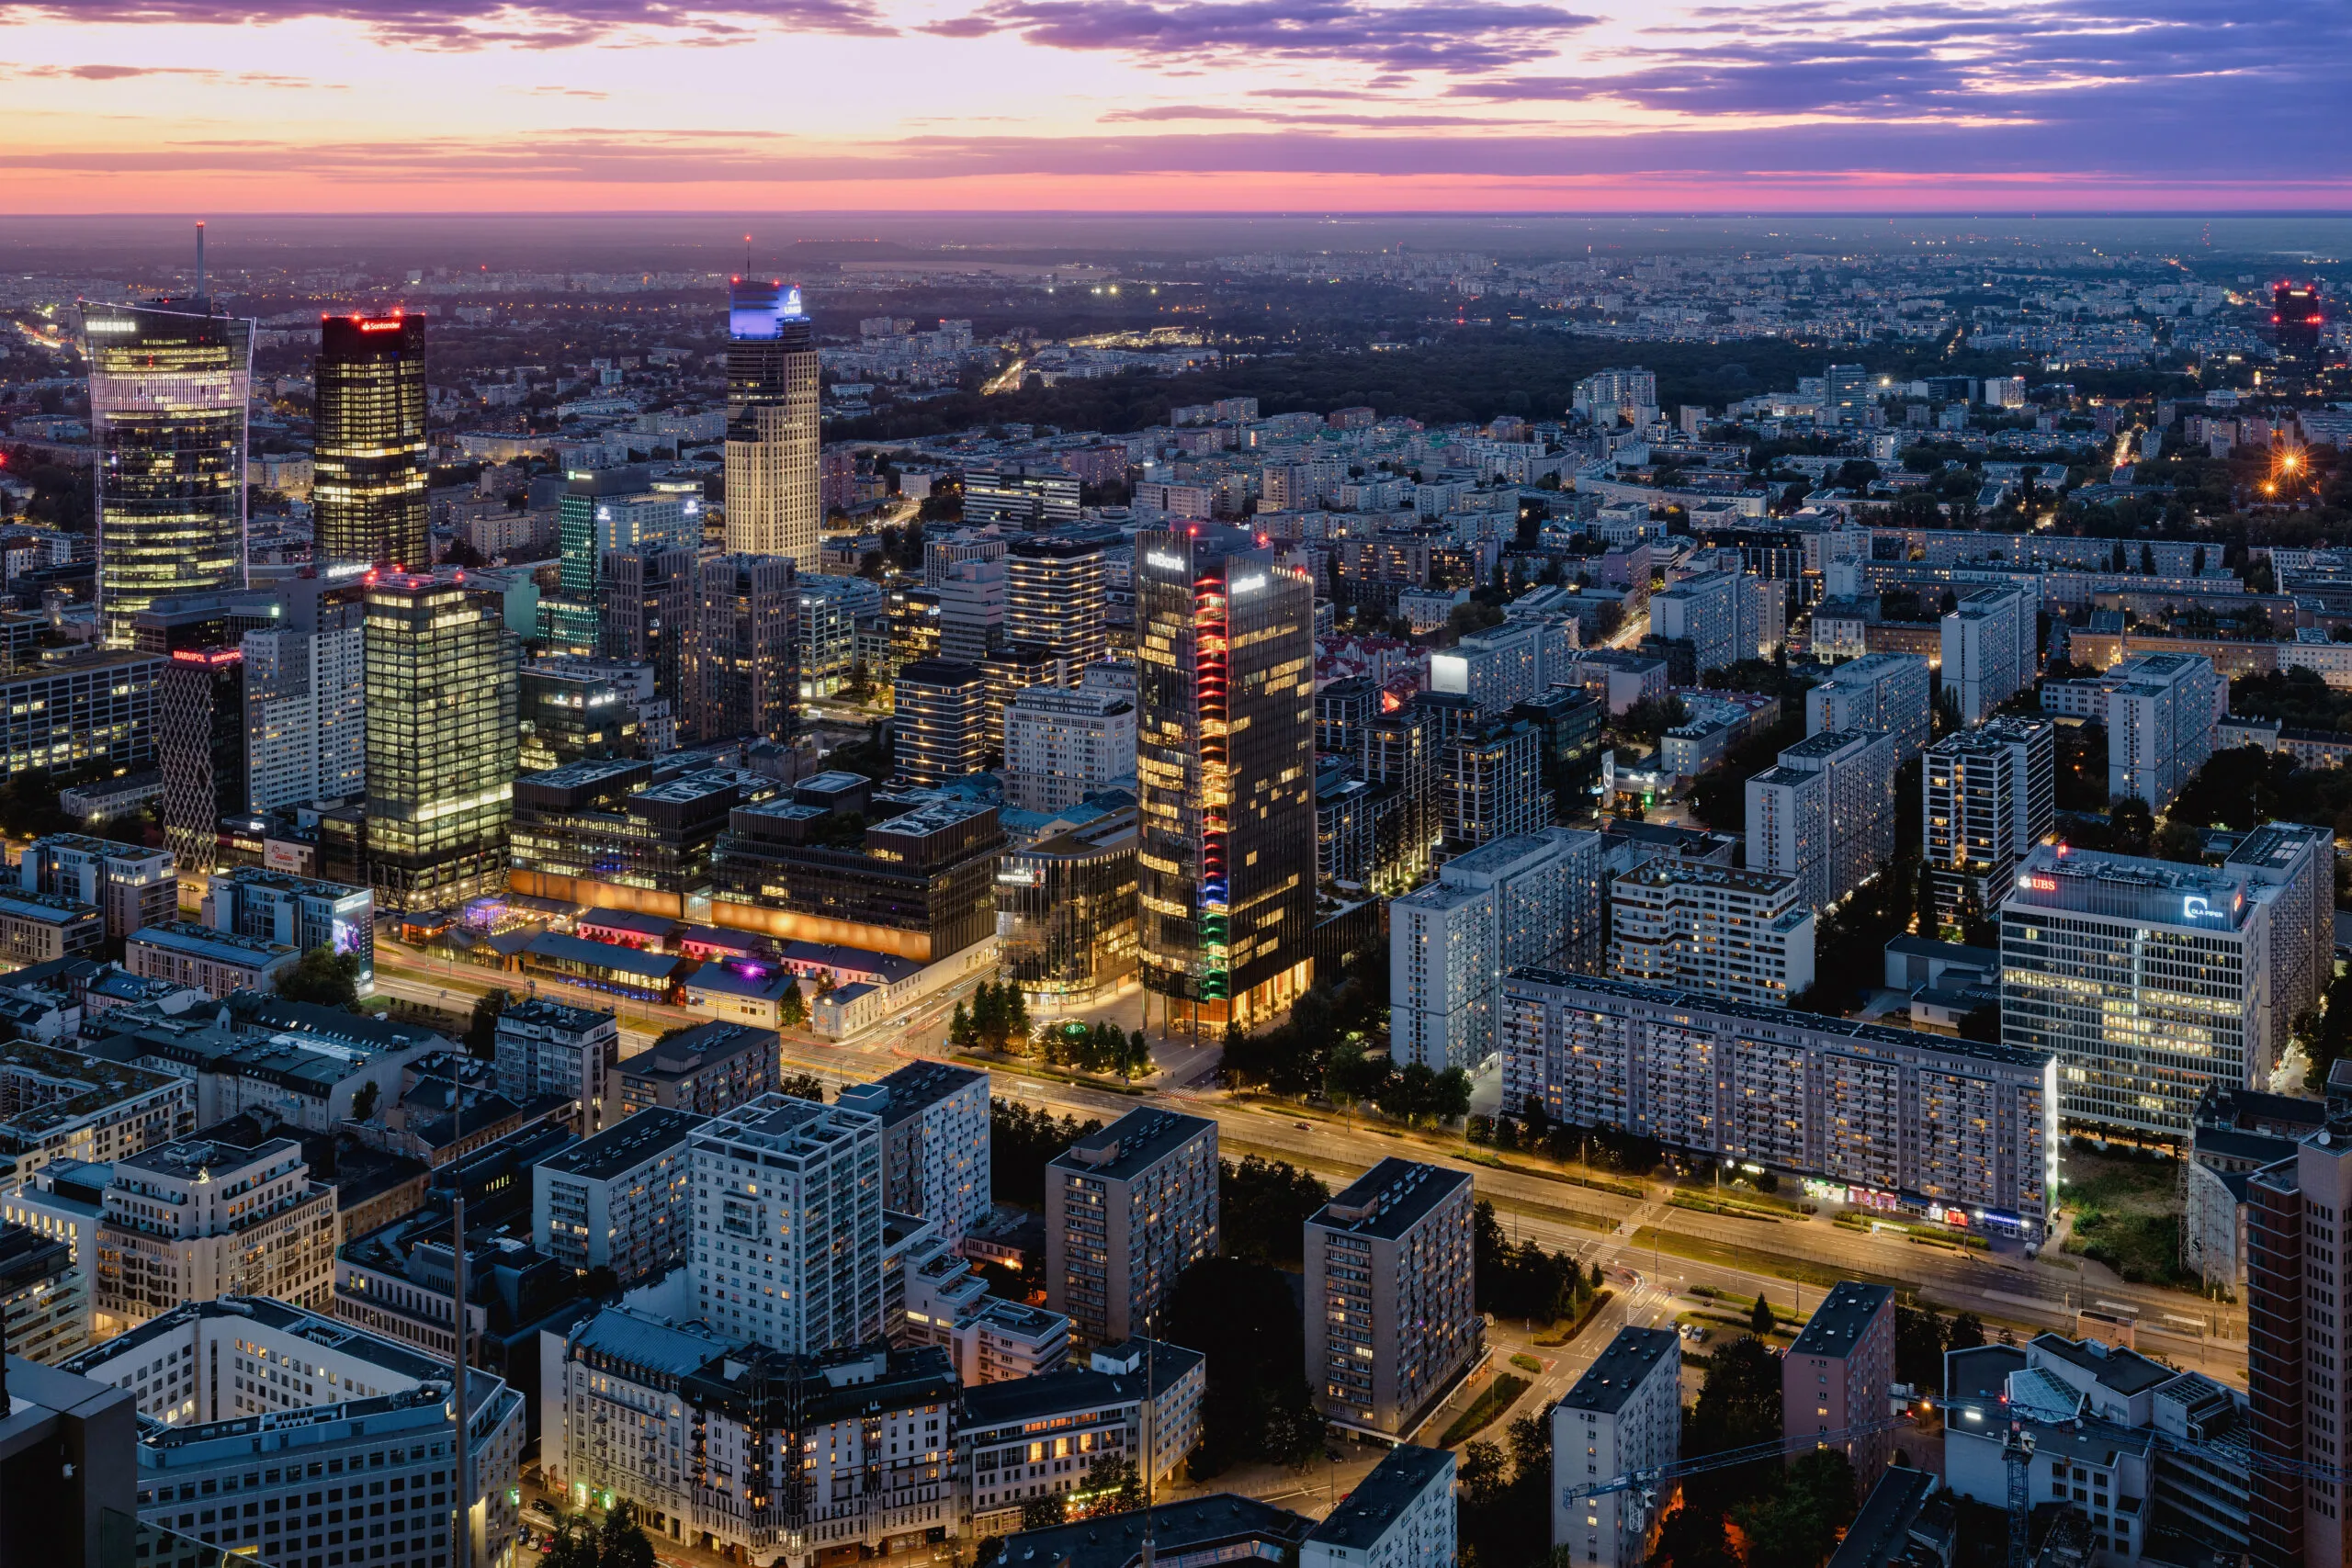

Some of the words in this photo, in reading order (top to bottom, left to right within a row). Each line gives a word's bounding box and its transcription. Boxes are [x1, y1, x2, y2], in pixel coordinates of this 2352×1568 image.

[85, 321, 136, 332] SAMSUNG
[369, 321, 401, 330] Santander
[1147, 551, 1184, 571] mBank
[174, 650, 207, 662] MARVIPOL
[210, 650, 242, 662] MARVIPOL
[2032, 878, 2055, 890] UBS
